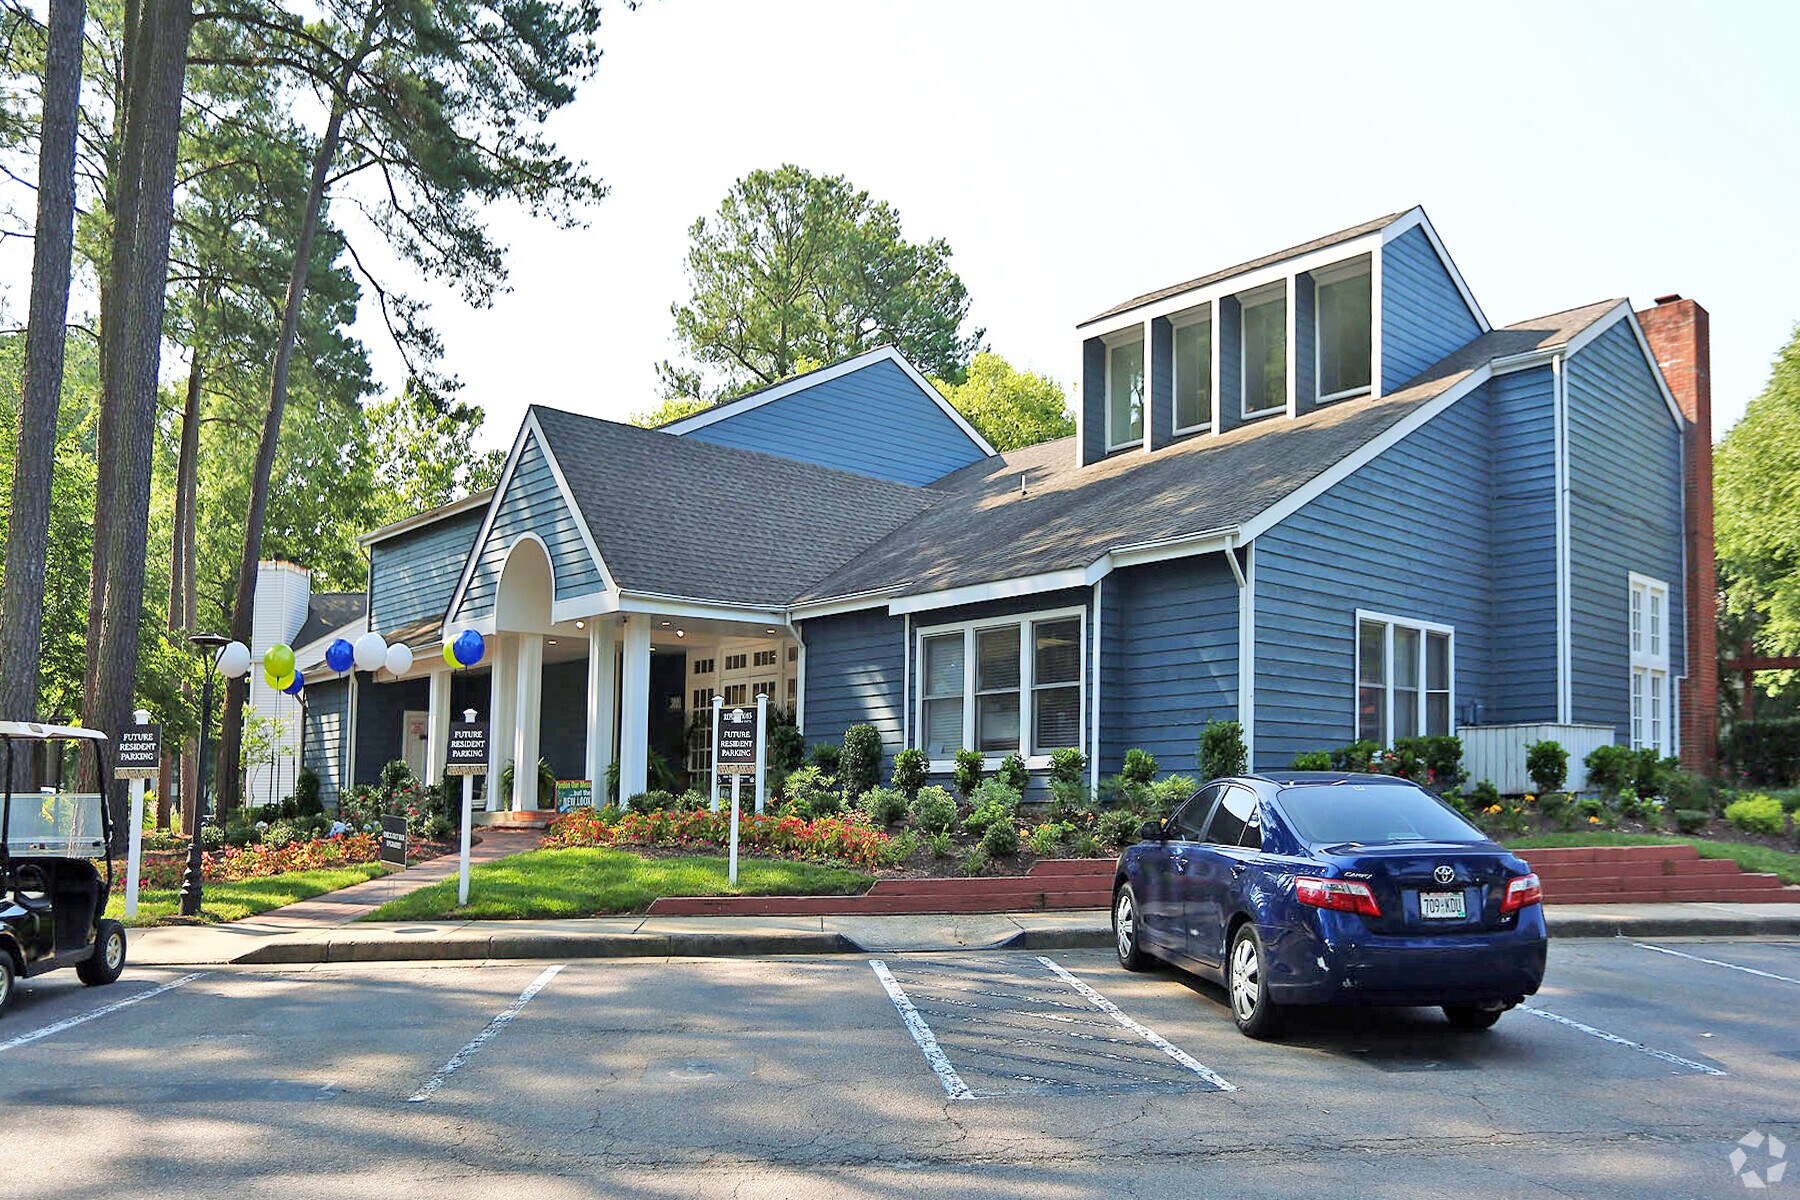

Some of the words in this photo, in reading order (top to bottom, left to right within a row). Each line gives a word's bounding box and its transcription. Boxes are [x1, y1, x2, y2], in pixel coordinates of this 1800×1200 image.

[123, 733, 154, 741] FUTURE
[120, 743, 157, 751] RESIDENT
[451, 740, 486, 748] RESIDENT
[720, 740, 753, 748] RESIDENT
[121, 752, 154, 760] PARKING
[721, 749, 751, 757] PARKING
